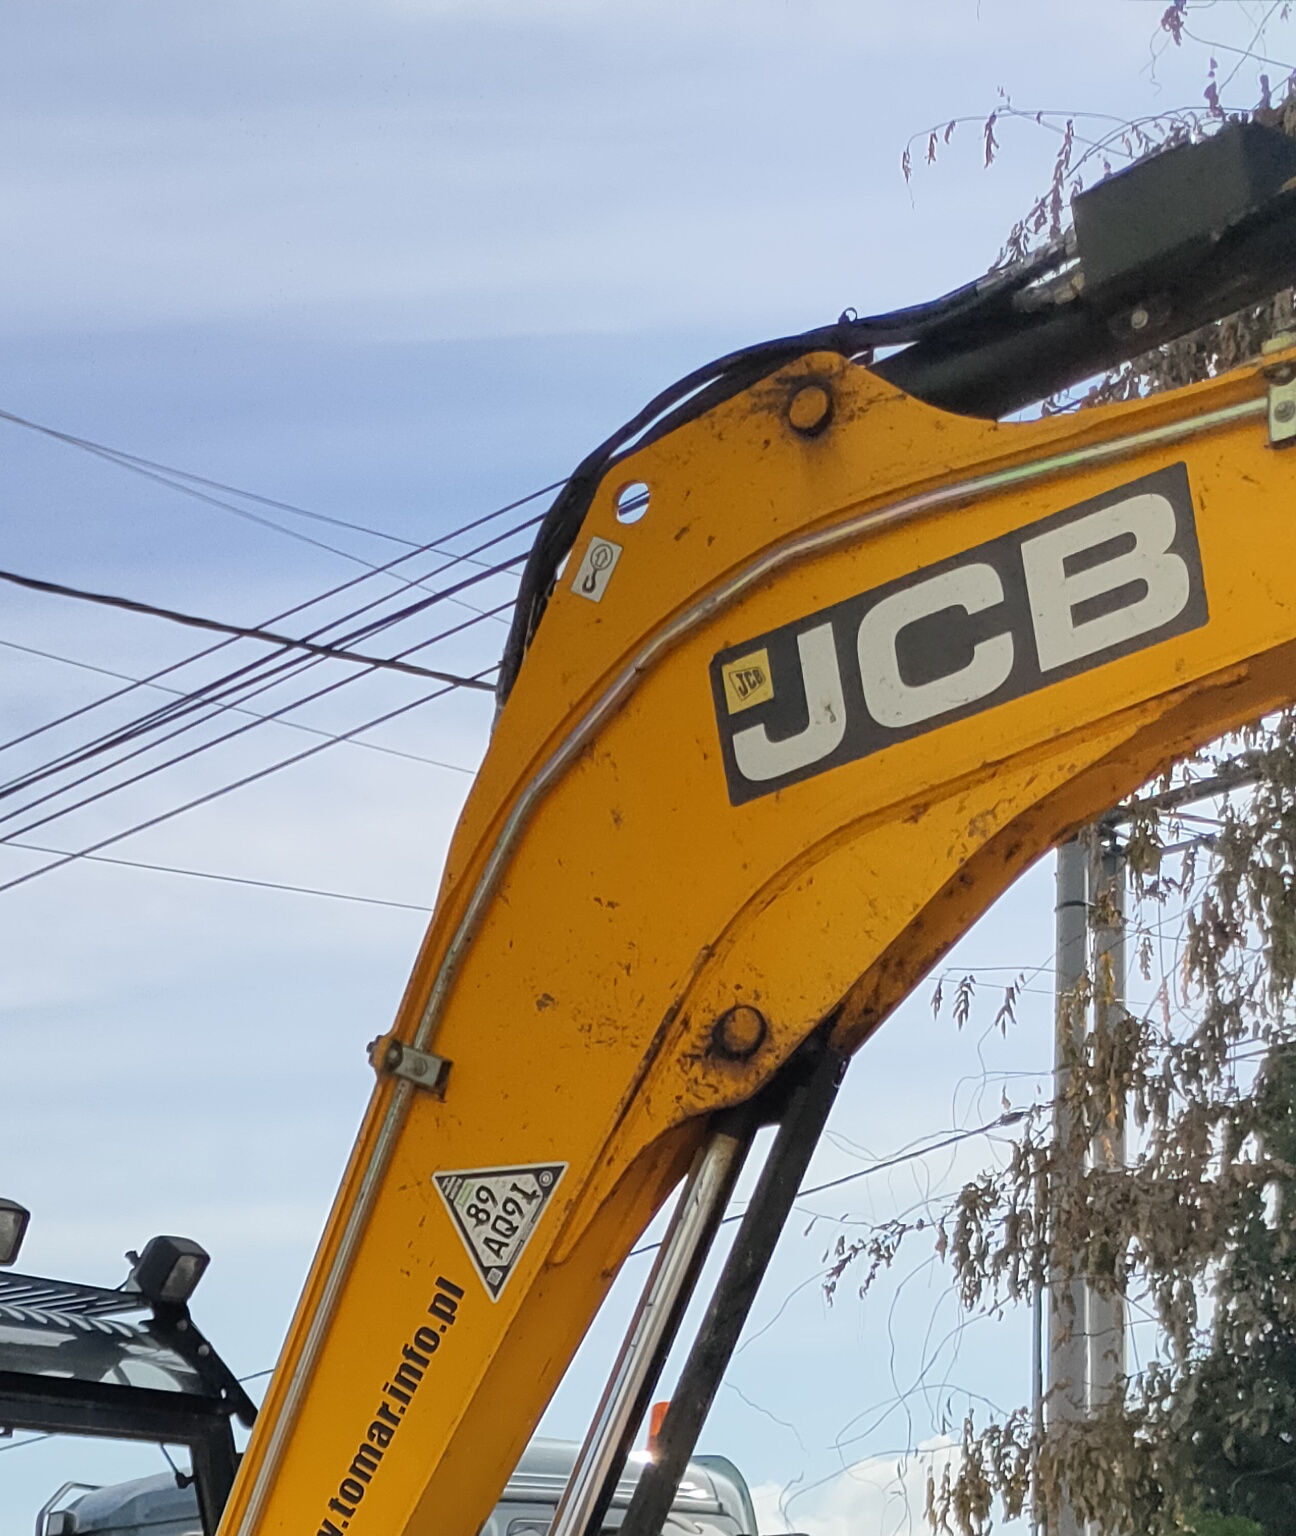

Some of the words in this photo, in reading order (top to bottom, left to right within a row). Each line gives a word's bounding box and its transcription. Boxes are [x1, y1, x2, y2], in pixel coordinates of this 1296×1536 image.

[731, 493, 1191, 782] JCB
[735, 669, 764, 697] JCB
[466, 1185, 498, 1226] 89
